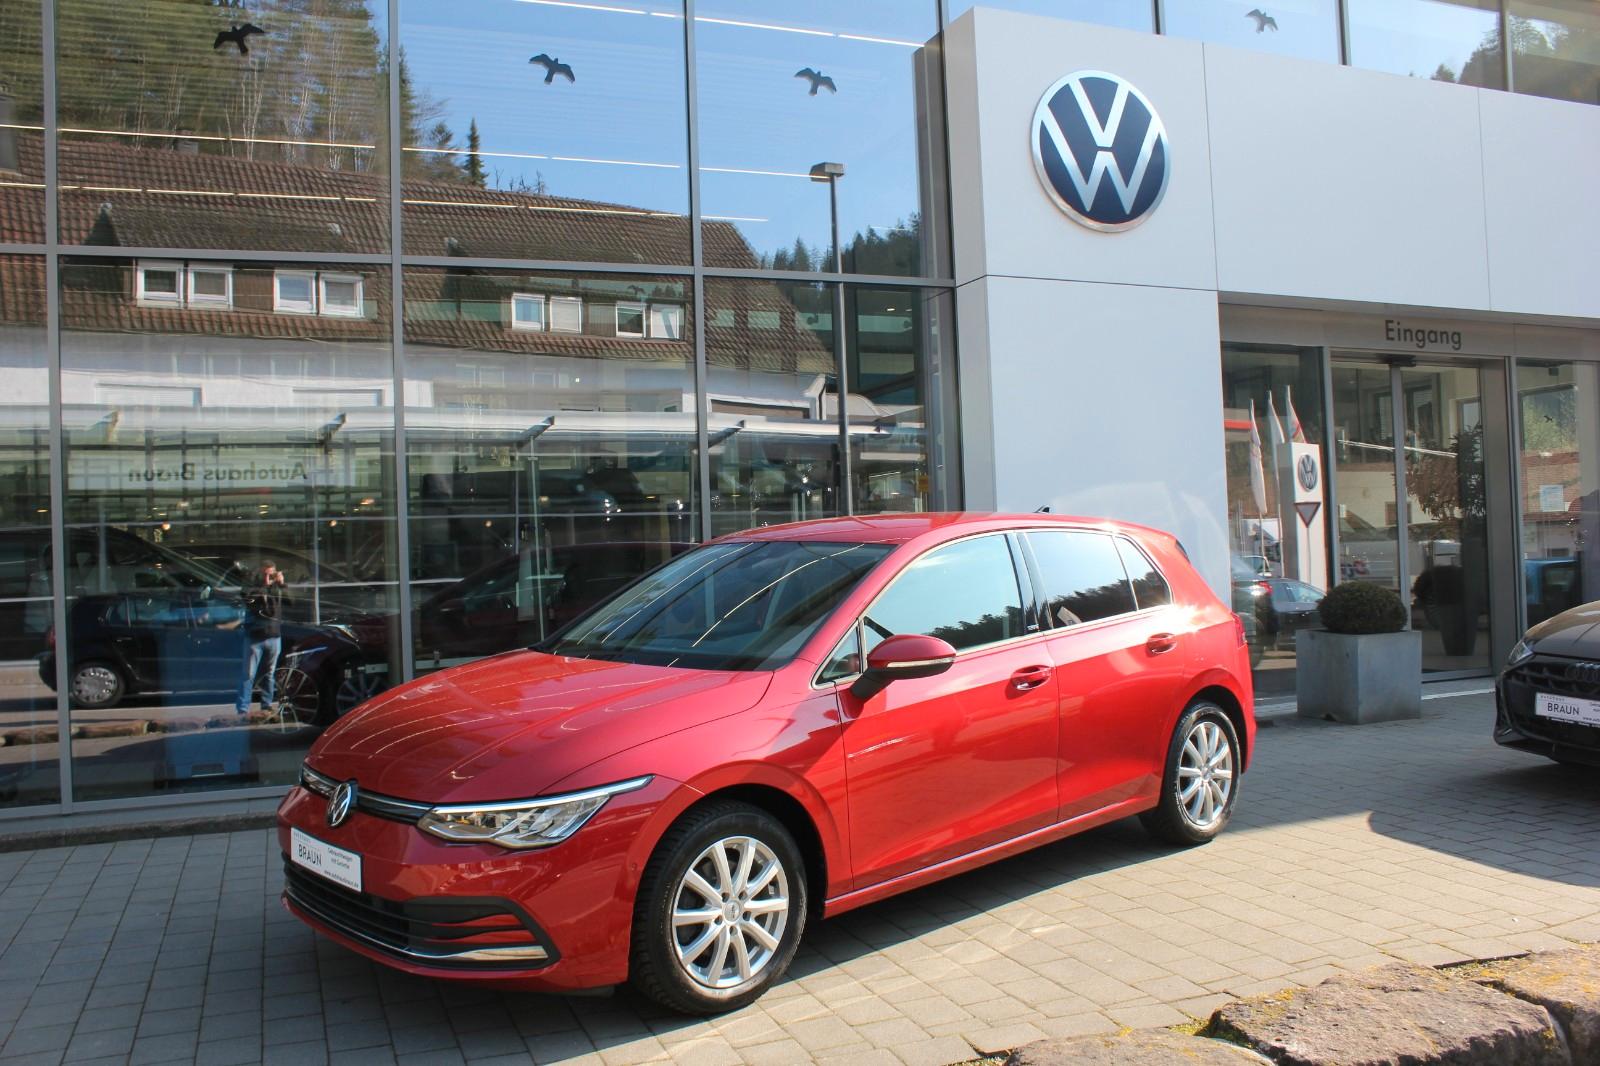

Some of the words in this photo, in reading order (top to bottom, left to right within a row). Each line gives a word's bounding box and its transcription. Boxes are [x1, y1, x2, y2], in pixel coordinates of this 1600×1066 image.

[1033, 71, 1168, 218] VW
[1385, 319, 1461, 350] Eingang
[1547, 702, 1580, 716] BRAUN
[298, 843, 322, 866] BRAUN
